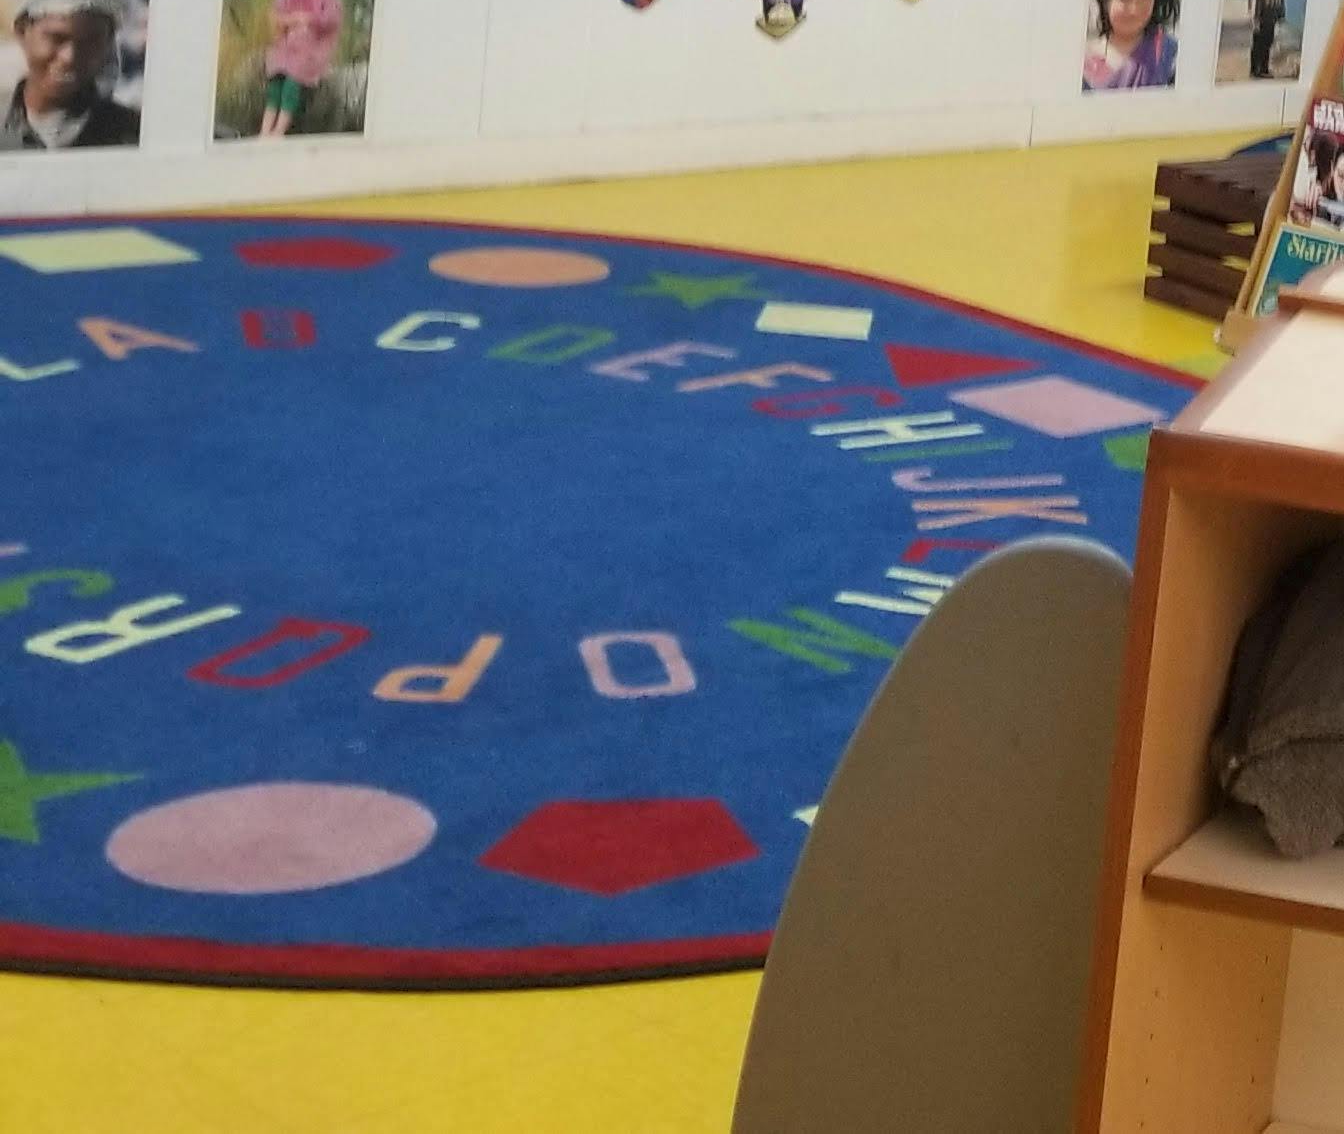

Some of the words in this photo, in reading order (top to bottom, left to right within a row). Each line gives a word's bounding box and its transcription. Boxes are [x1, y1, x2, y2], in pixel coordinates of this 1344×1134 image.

[77, 315, 201, 361] A
[238, 308, 317, 349] B
[375, 310, 481, 353] C
[488, 324, 616, 363] D
[588, 340, 739, 382] E
[676, 360, 835, 394] F
[809, 410, 985, 451] H
[891, 467, 1066, 493] J
[911, 495, 1089, 531] K
[23, 593, 243, 665] R
[726, 606, 905, 674] N
[186, 617, 374, 689] Q
[371, 633, 504, 705] P
[576, 631, 698, 700] O
